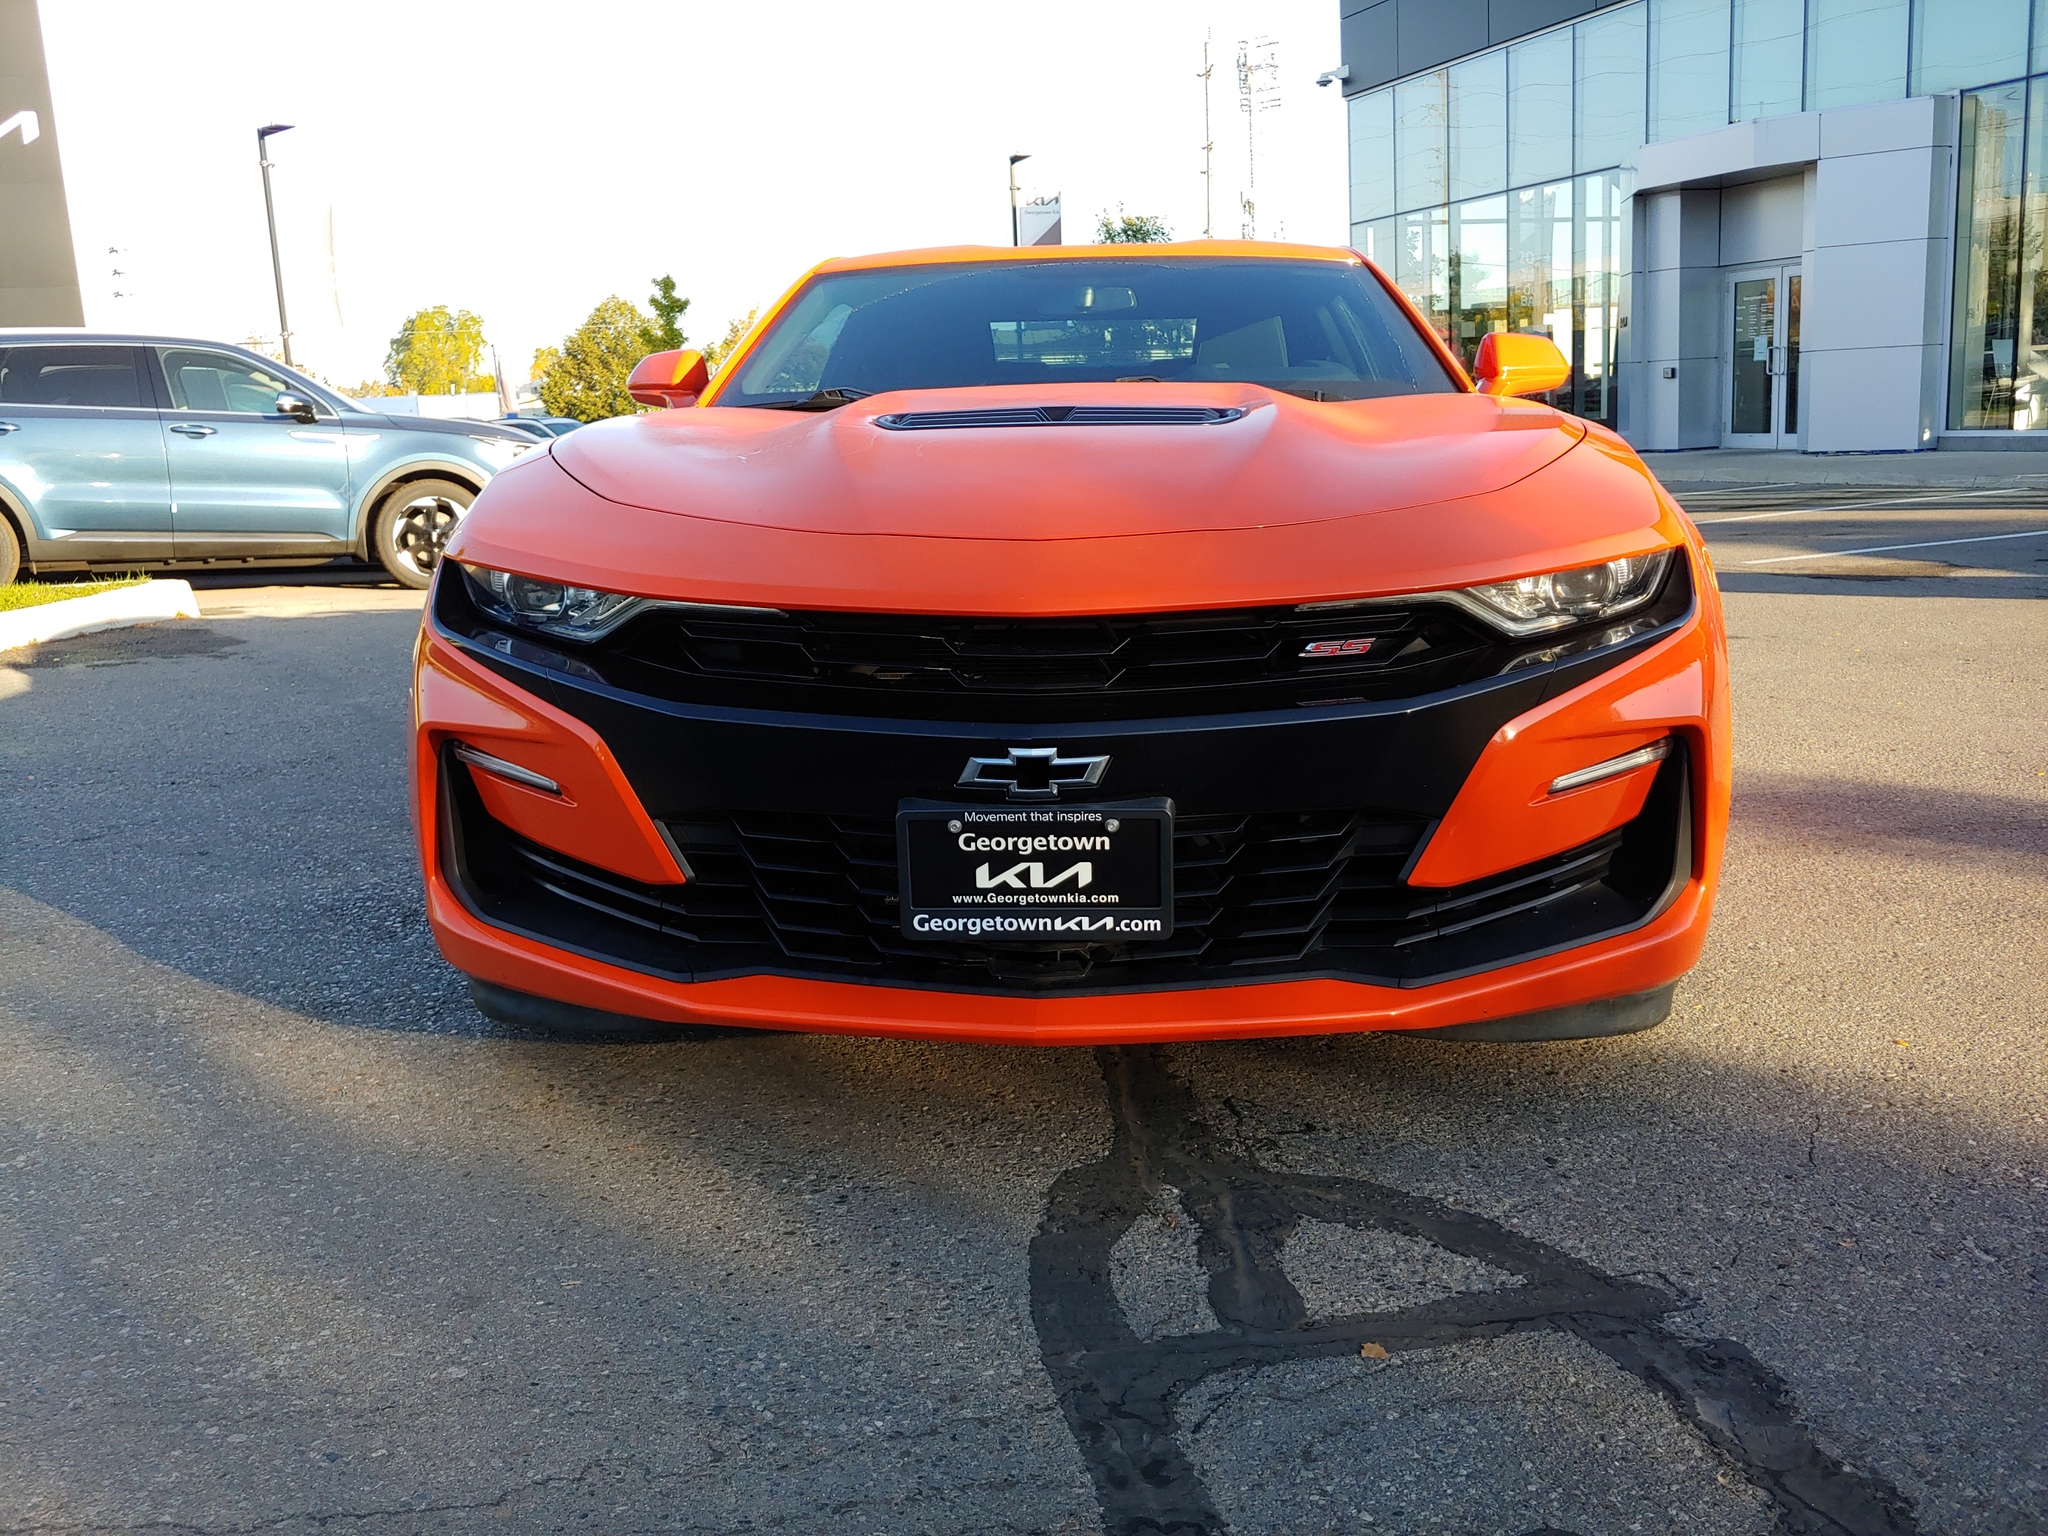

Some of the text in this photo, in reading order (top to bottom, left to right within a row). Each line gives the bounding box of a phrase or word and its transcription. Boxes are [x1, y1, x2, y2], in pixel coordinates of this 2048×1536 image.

[964, 810, 1102, 824] Movement that inspires
[958, 833, 1110, 854] Georgetown
[976, 862, 1092, 888] KIA
[952, 893, 1119, 905] www.Georgetownkia.com
